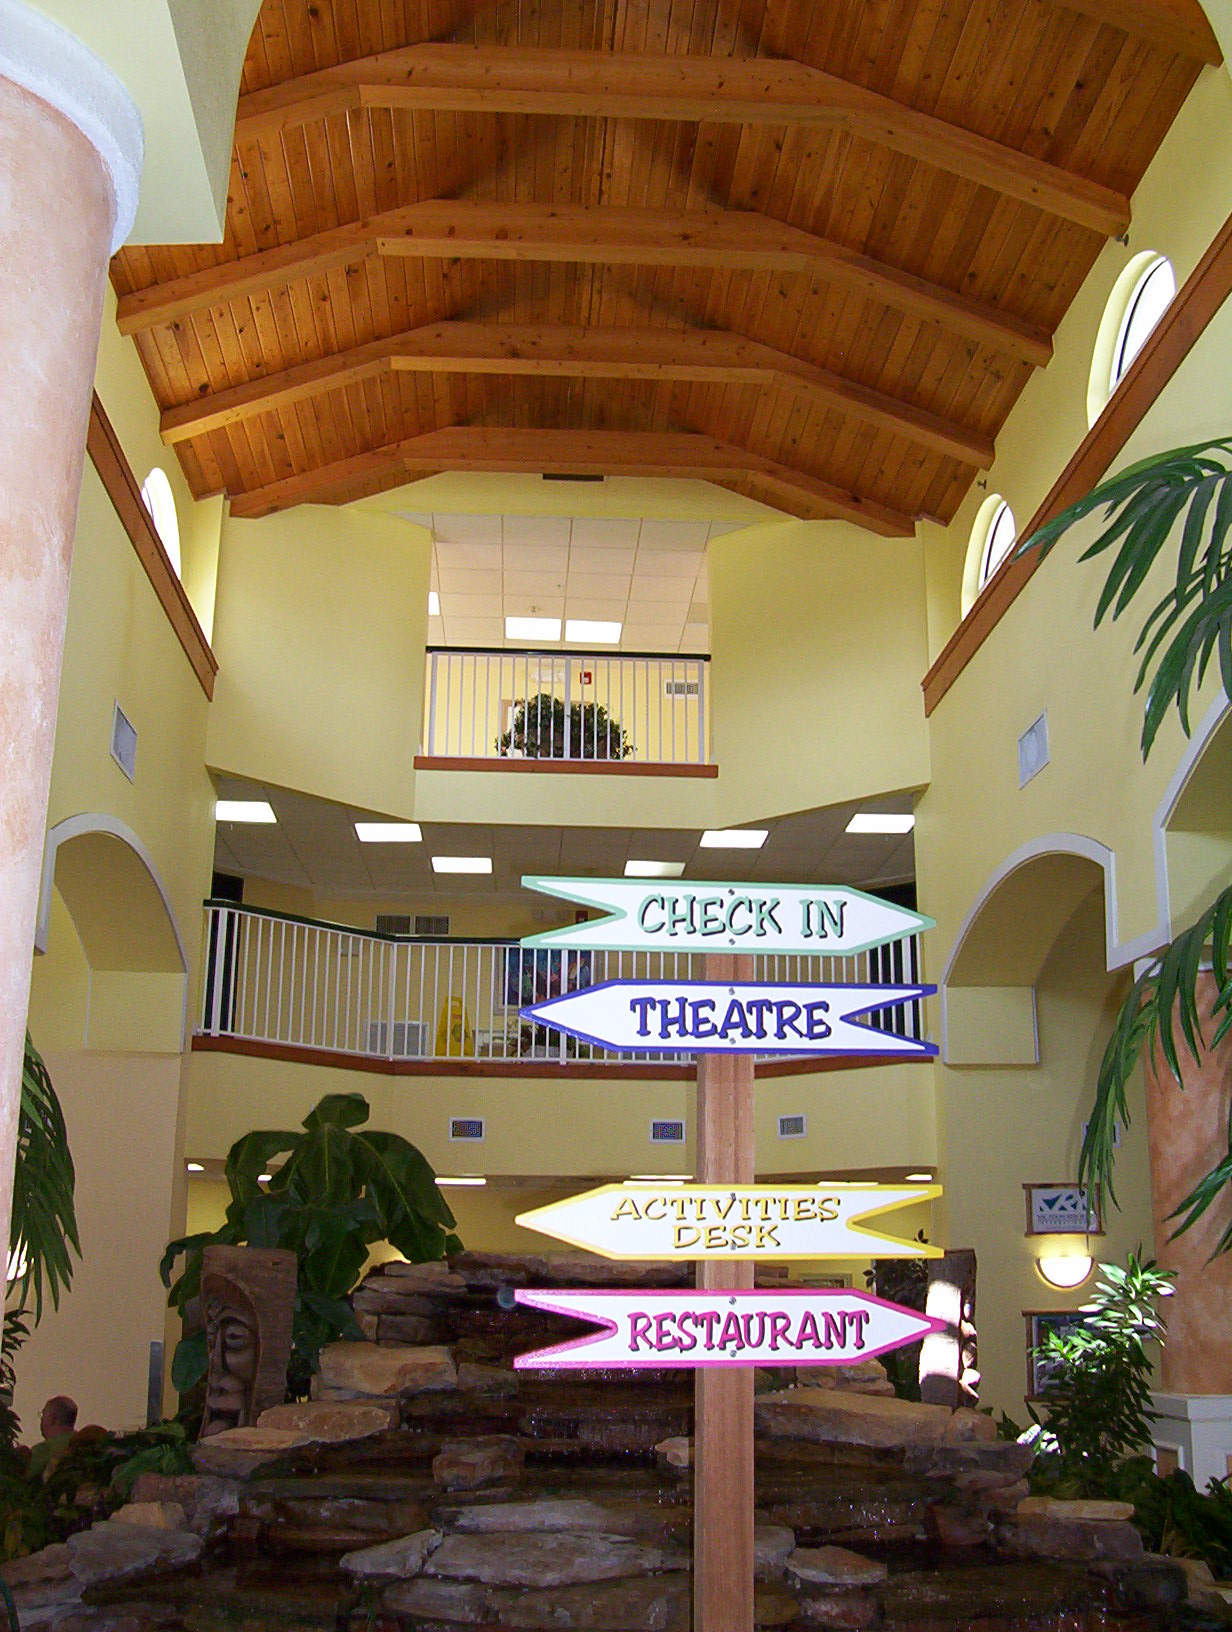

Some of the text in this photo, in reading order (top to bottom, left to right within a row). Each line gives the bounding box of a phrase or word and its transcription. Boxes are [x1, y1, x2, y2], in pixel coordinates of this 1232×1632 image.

[638, 893, 848, 938] CHECK IN
[629, 997, 832, 1039] THEATRE
[610, 1197, 841, 1221] ACTIVITIES
[671, 1224, 781, 1248] DESK
[627, 1311, 870, 1353] RESTAURANT
